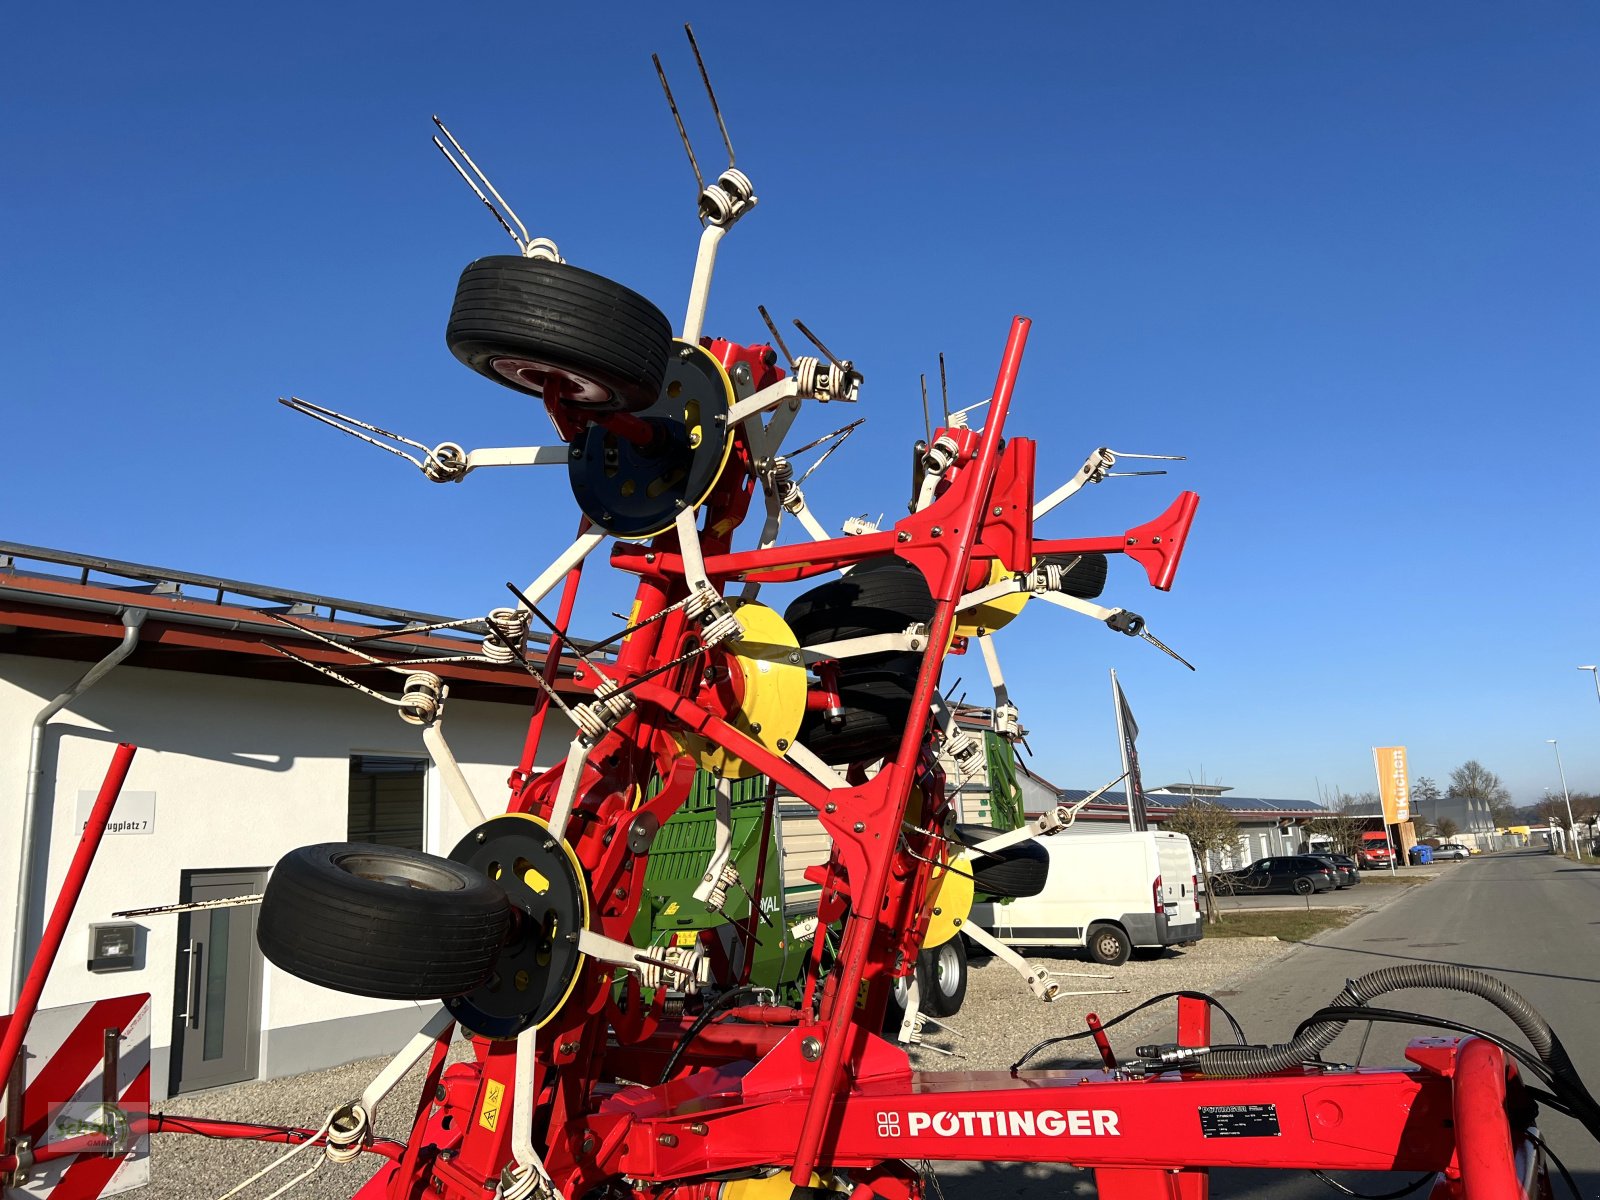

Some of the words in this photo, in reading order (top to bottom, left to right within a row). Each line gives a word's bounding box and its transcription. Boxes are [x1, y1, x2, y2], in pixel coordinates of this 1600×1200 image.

[1393, 750, 1407, 807] Küchen
[142, 821, 147, 830] 7
[907, 1110, 1121, 1137] PÖTTINGER
